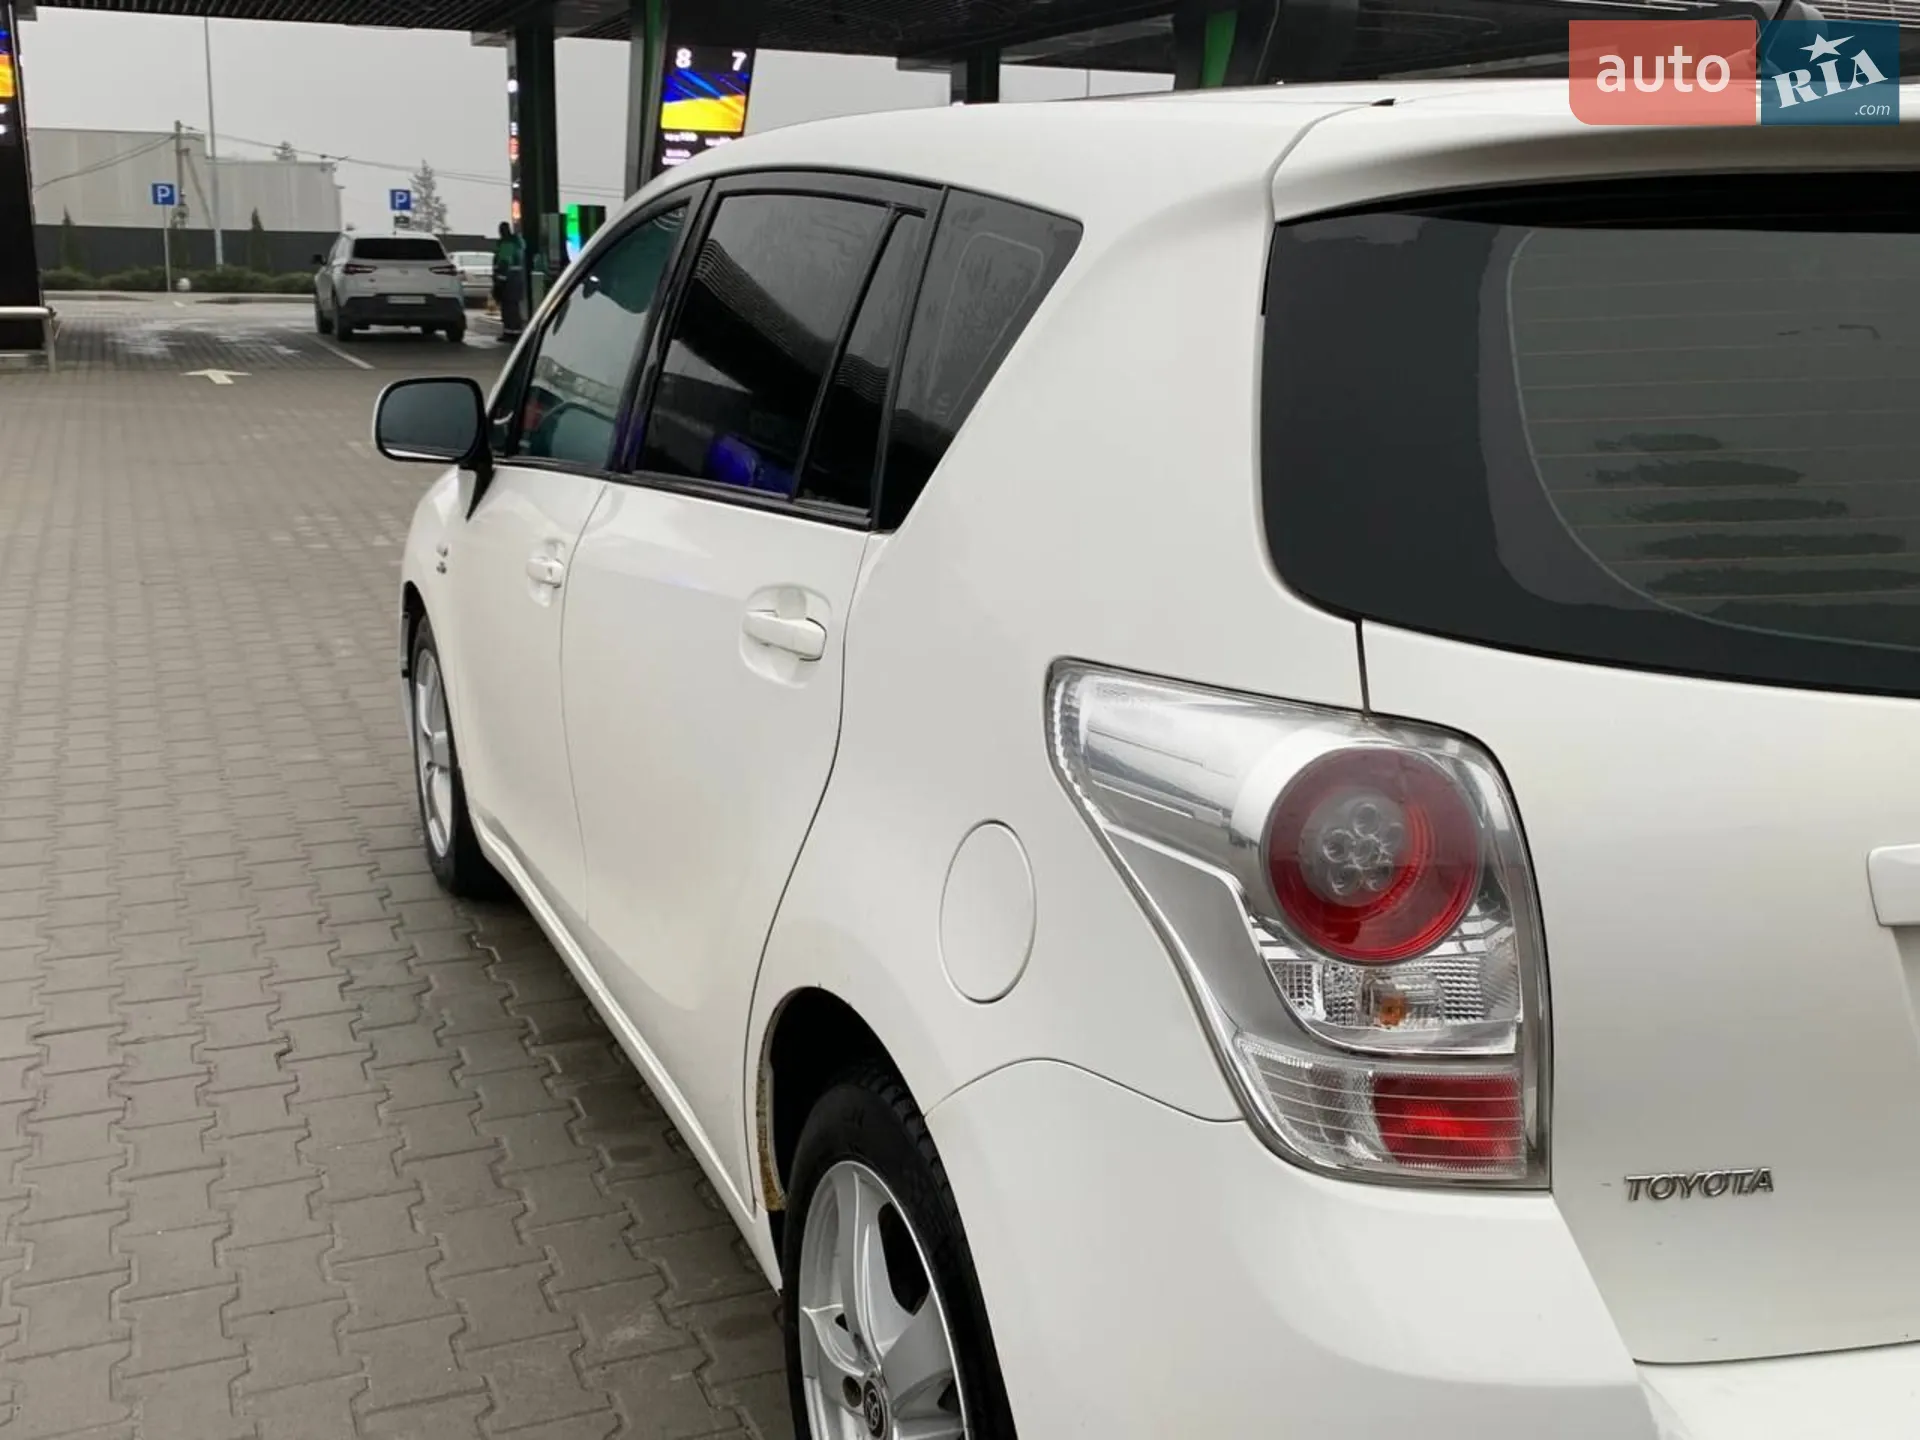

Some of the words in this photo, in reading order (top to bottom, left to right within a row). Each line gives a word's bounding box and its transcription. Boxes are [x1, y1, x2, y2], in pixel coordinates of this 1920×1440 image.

[675, 47, 692, 69] 8
[731, 50, 747, 71] 7
[157, 185, 170, 203] P
[395, 191, 408, 208] P
[1624, 1166, 1774, 1201] TOYOTA
